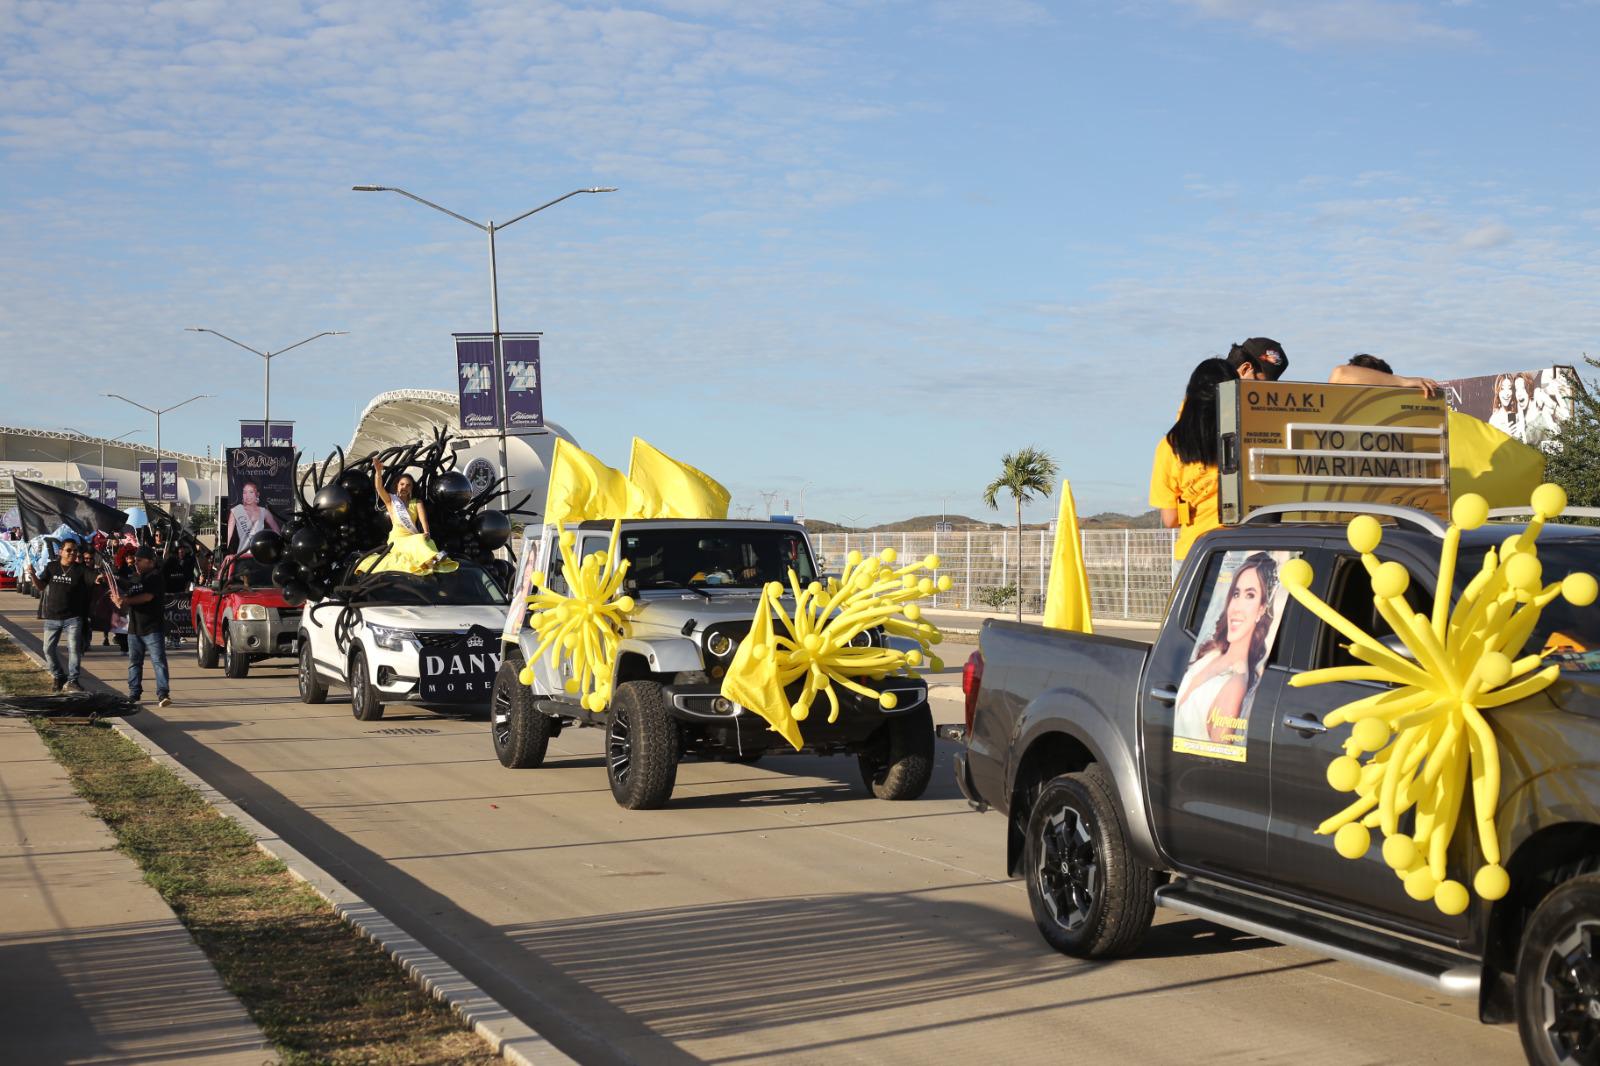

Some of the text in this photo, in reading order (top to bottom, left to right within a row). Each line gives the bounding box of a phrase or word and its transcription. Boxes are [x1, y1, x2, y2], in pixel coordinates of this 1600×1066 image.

[1313, 430, 1404, 452] YO CON
[1296, 455, 1422, 478] MARIANA!!
[426, 652, 502, 676] DANY
[428, 681, 492, 692] MORE
